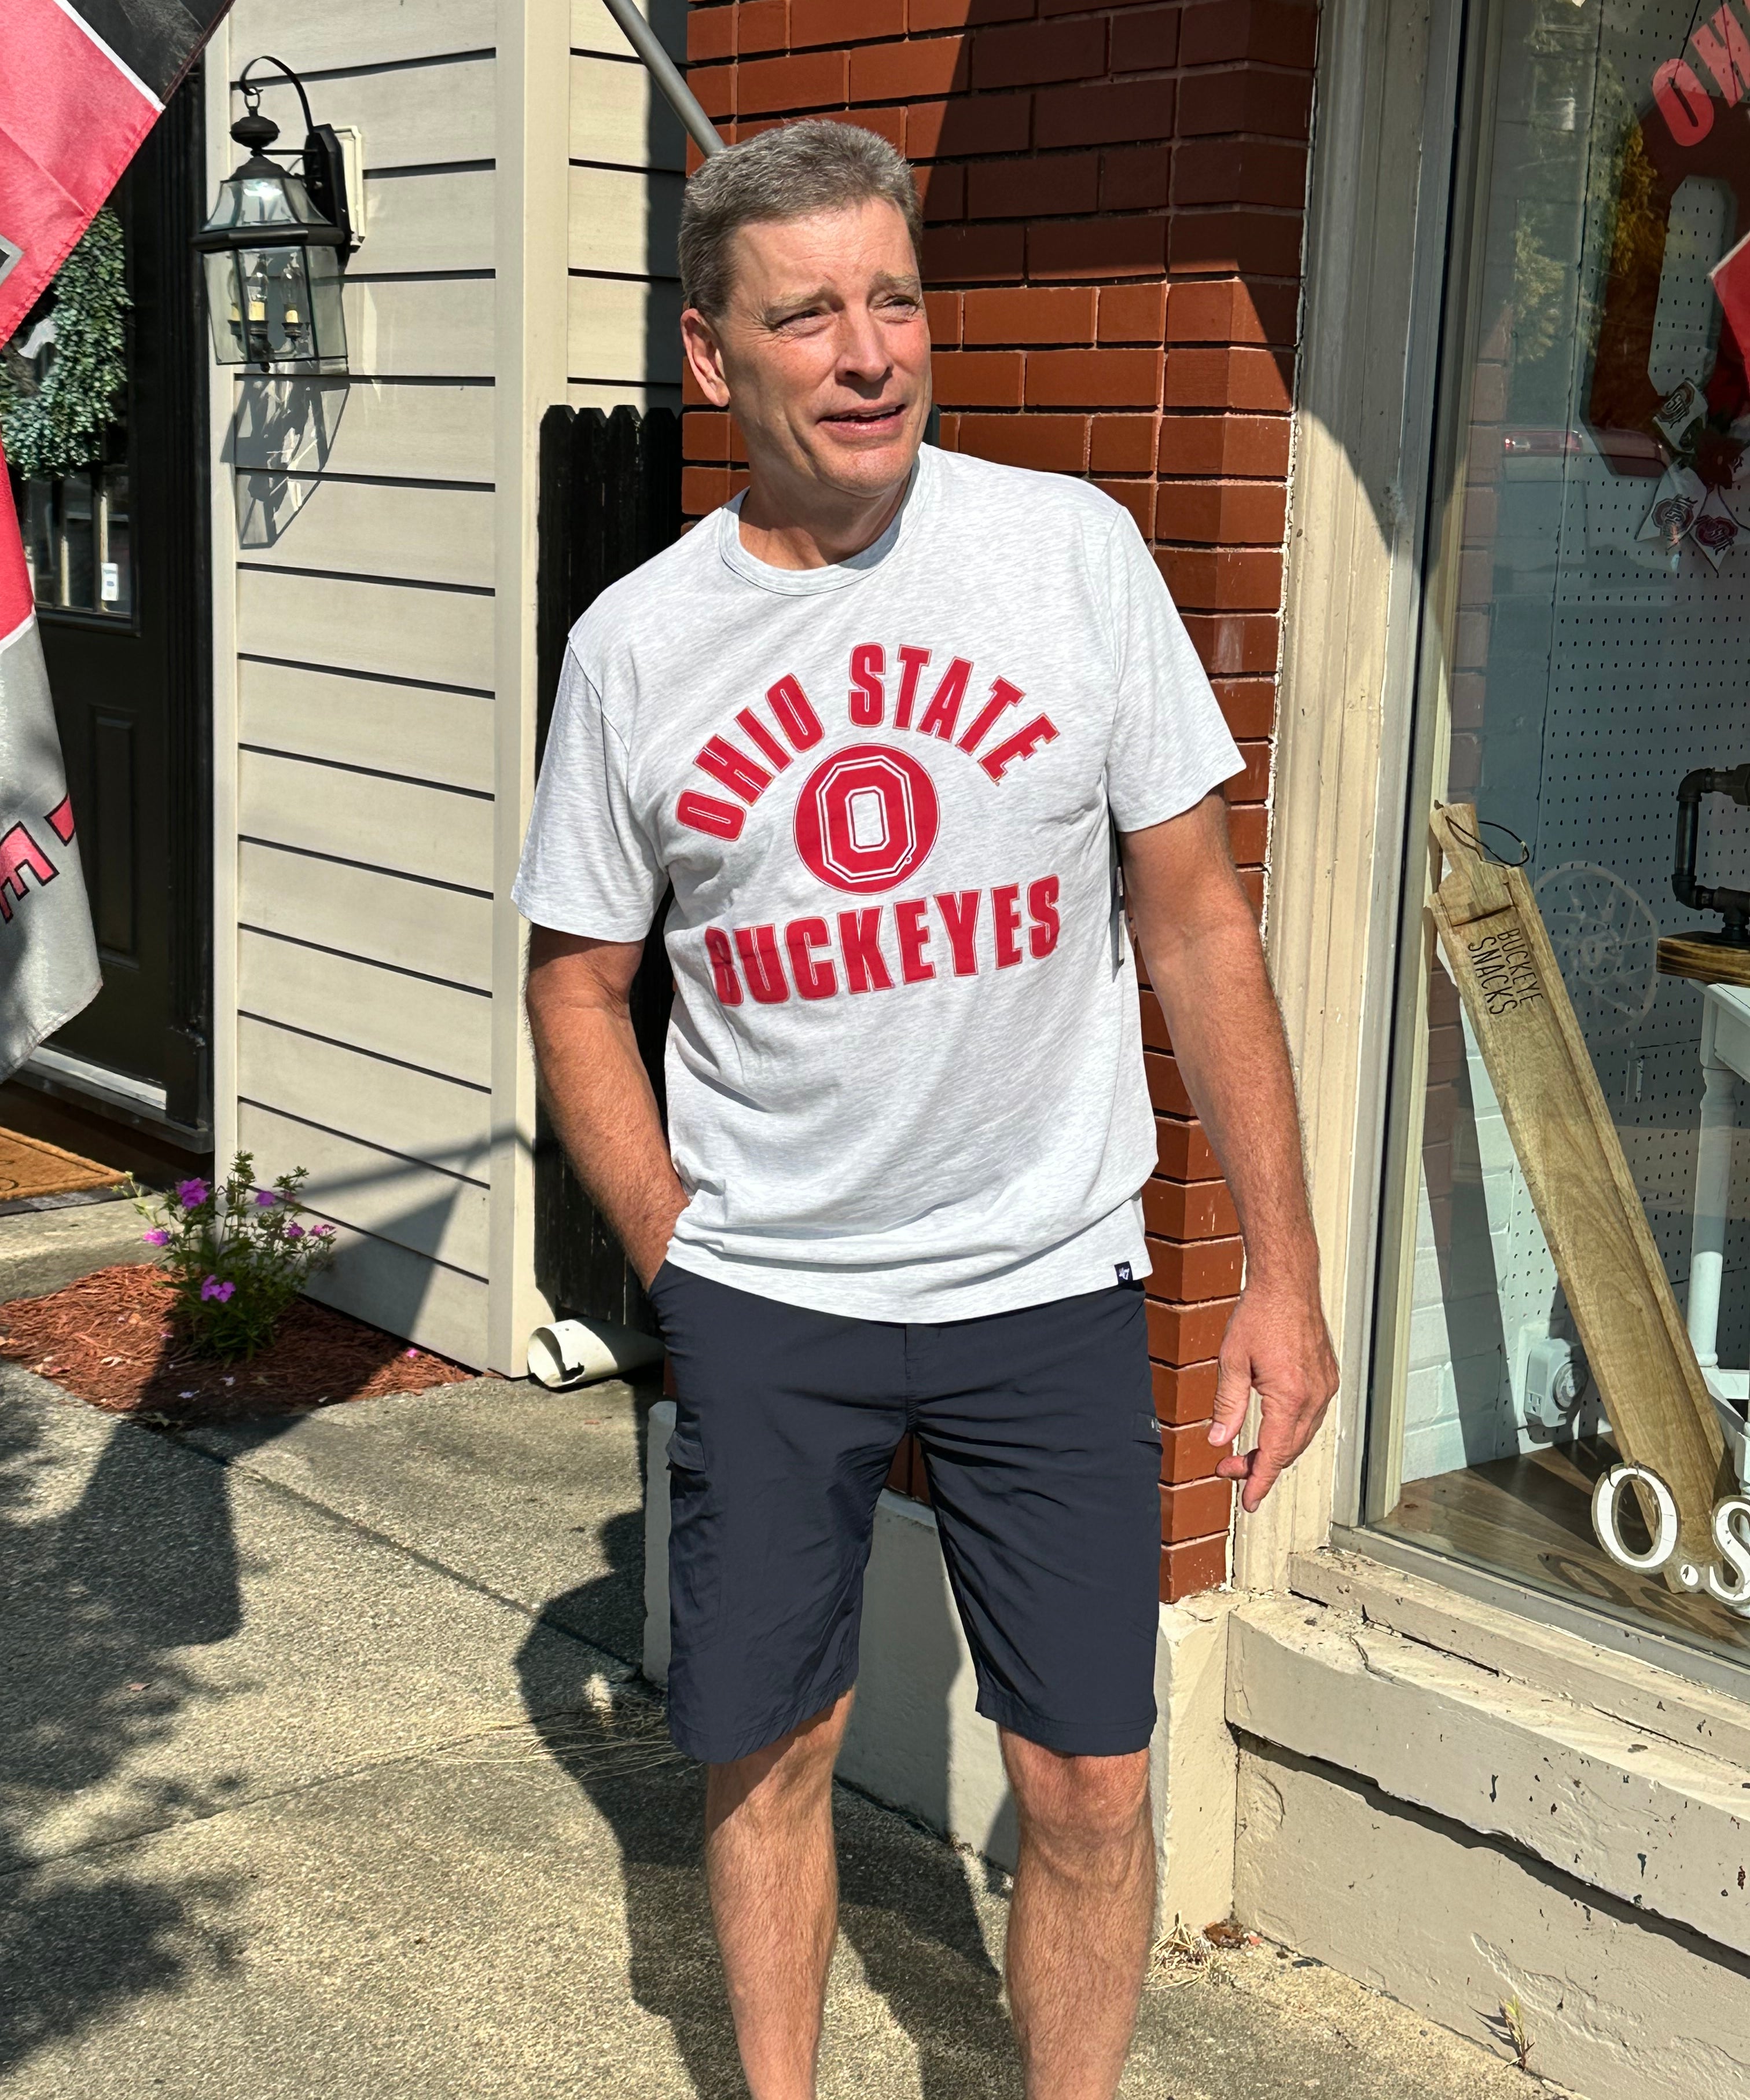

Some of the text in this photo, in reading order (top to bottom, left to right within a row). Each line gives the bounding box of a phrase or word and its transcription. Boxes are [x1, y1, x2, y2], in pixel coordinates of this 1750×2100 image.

[676, 642, 1061, 842] OHIO STATE
[704, 873, 1061, 1007] BUCKEYES
[1468, 937, 1517, 1015] SNACKS
[1497, 928, 1544, 1004] BUCKEYE
